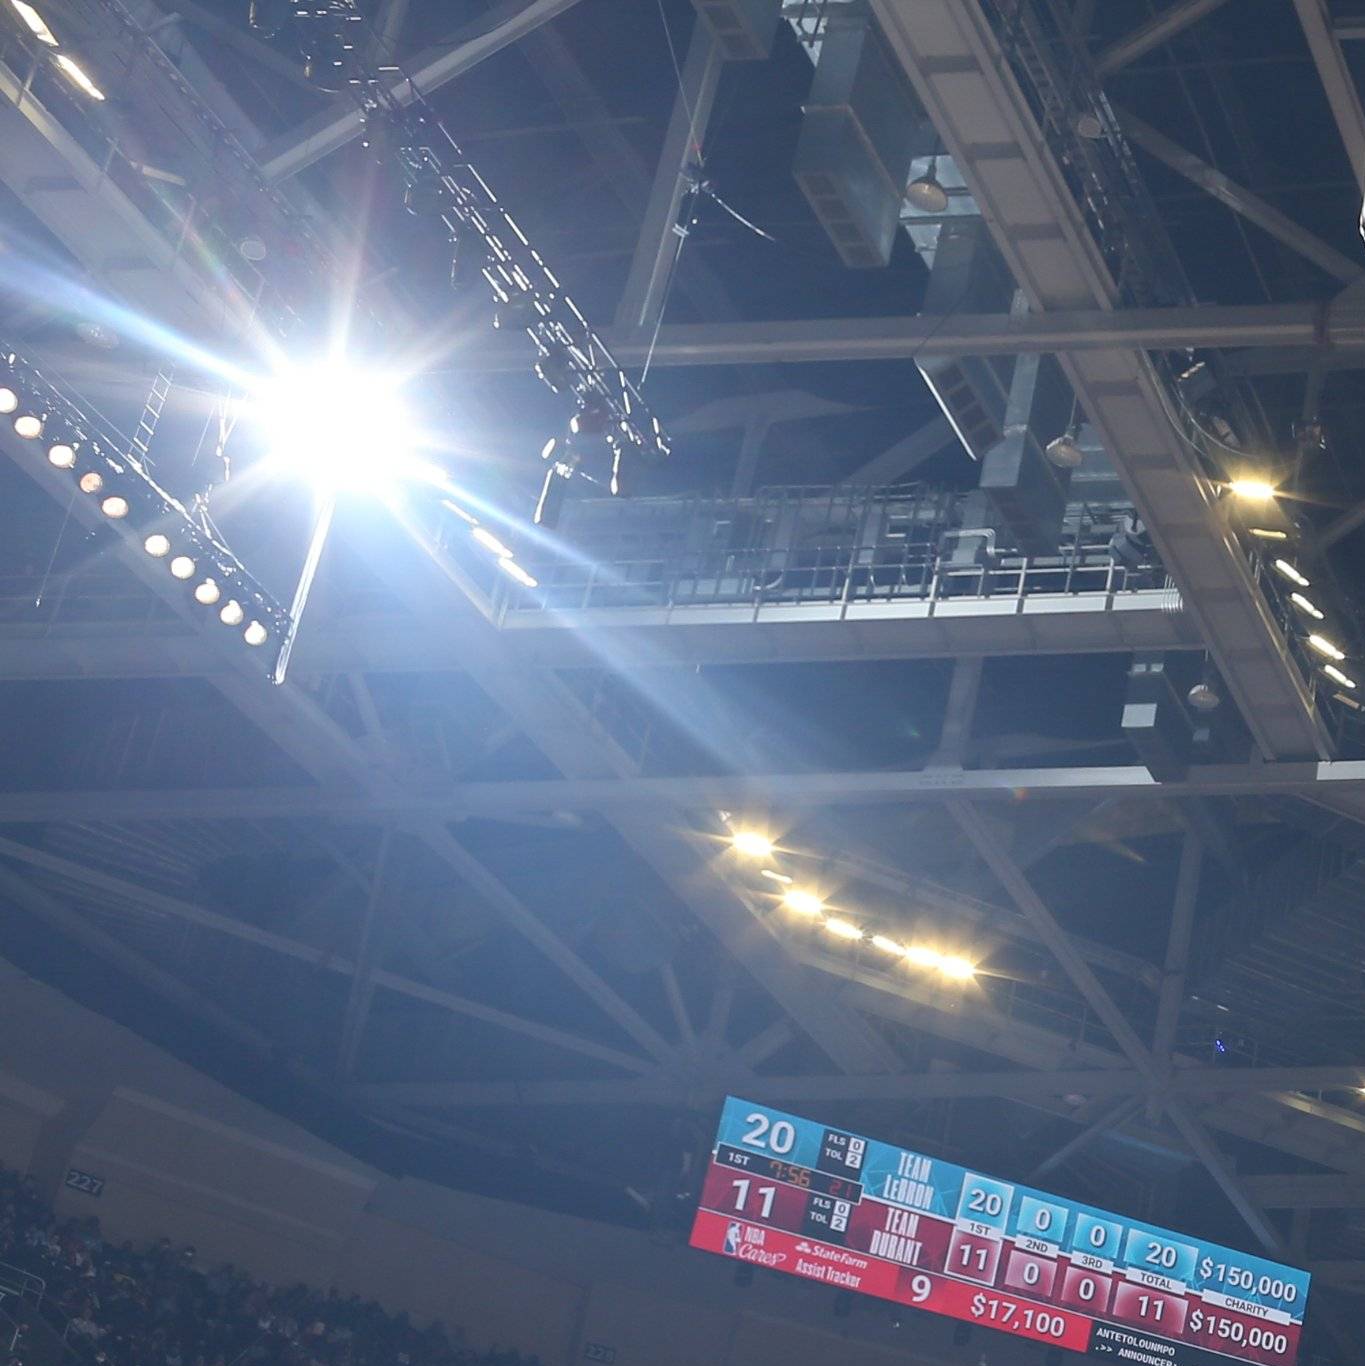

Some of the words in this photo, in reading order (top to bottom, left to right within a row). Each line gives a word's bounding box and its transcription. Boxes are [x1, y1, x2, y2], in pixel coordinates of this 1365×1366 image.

[742, 1113, 795, 1153] 20
[828, 1134, 845, 1146] FLS
[728, 1152, 750, 1166] 1ST
[770, 1160, 811, 1188] 7:56
[825, 1148, 842, 1161] TOL
[899, 1152, 932, 1183] TEAM
[732, 1179, 776, 1218] 11
[813, 1198, 831, 1211] FLS
[810, 1211, 828, 1225] TOL
[885, 1208, 919, 1238] TEAM
[870, 1230, 923, 1266] DURANT
[968, 1189, 1001, 1216] 20
[1035, 1209, 1051, 1230] 0
[1090, 1225, 1105, 1247] 0
[1146, 1242, 1177, 1267] 20
[1200, 1257, 1297, 1302] $150,000
[795, 1258, 826, 1280] Assist
[827, 1265, 861, 1288] Tracker
[970, 1222, 991, 1236] 1ST
[1025, 1239, 1048, 1253] 2ND
[1082, 1256, 1102, 1268] 3RD
[1140, 1272, 1172, 1289] TOTAL
[1225, 1298, 1268, 1317] CHARITY
[911, 1275, 931, 1302] 9
[959, 1244, 988, 1271] 11
[1023, 1262, 1039, 1285] 0
[1079, 1278, 1095, 1300] 0
[1138, 1295, 1165, 1321] 11
[1189, 1309, 1287, 1354] $150,000
[970, 1292, 1065, 1338] $17,100
